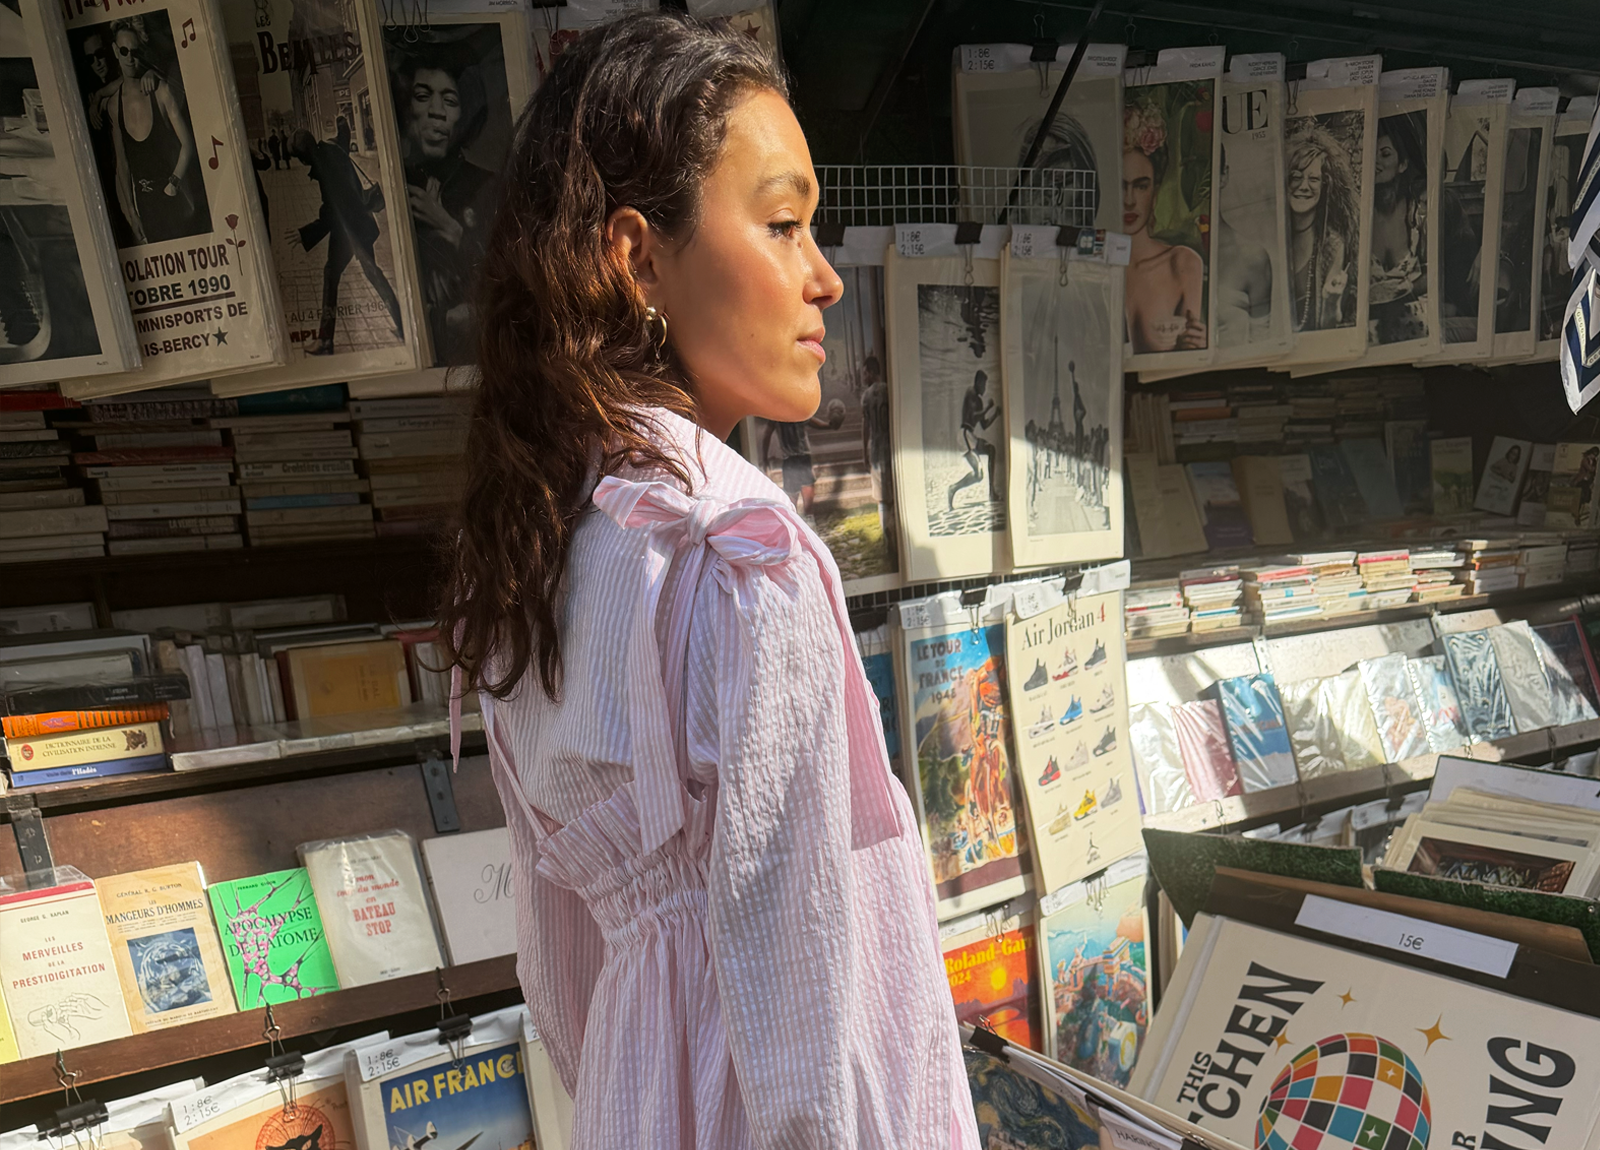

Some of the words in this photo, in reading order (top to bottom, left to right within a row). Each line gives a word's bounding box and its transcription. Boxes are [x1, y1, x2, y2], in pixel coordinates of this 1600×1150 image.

[122, 250, 187, 283] OLATION
[188, 244, 230, 272] TOUR
[188, 274, 231, 297] 1990
[227, 301, 248, 318] DE
[366, 301, 389, 313] 196
[1022, 622, 1045, 652] Air
[1048, 608, 1095, 644] Jordan
[1097, 602, 1107, 622] 4
[917, 645, 929, 661] LE
[929, 638, 962, 658] TOUR
[919, 666, 964, 688] FRANCE
[42, 746, 85, 758] CIVILISATION
[45, 738, 91, 750] DICTIONNAIRE
[93, 737, 103, 745] DE
[116, 889, 143, 899] GÉNÉRAL
[159, 882, 182, 892] BURTON
[357, 884, 369, 894] du
[371, 878, 400, 891] monde
[365, 896, 377, 904] en
[20, 914, 41, 924] GEORGE
[49, 909, 70, 919] KAPLAN
[105, 907, 155, 926] MANGEURS
[157, 898, 204, 916] D'HOMMES
[224, 906, 313, 936] APOCALYPSE
[353, 902, 396, 922] BATEAU
[366, 919, 392, 937] STOP
[44, 935, 56, 943] LES
[256, 927, 318, 952] L'ATOME
[1398, 932, 1425, 952] 15€
[22, 941, 84, 962] MERVEILLES
[12, 962, 106, 990] PRESTIDIGITATION
[1187, 960, 1326, 1124] CHEN
[1176, 1050, 1213, 1105] THIS
[390, 1078, 431, 1114] AIR
[1115, 1129, 1161, 1150] HARING
